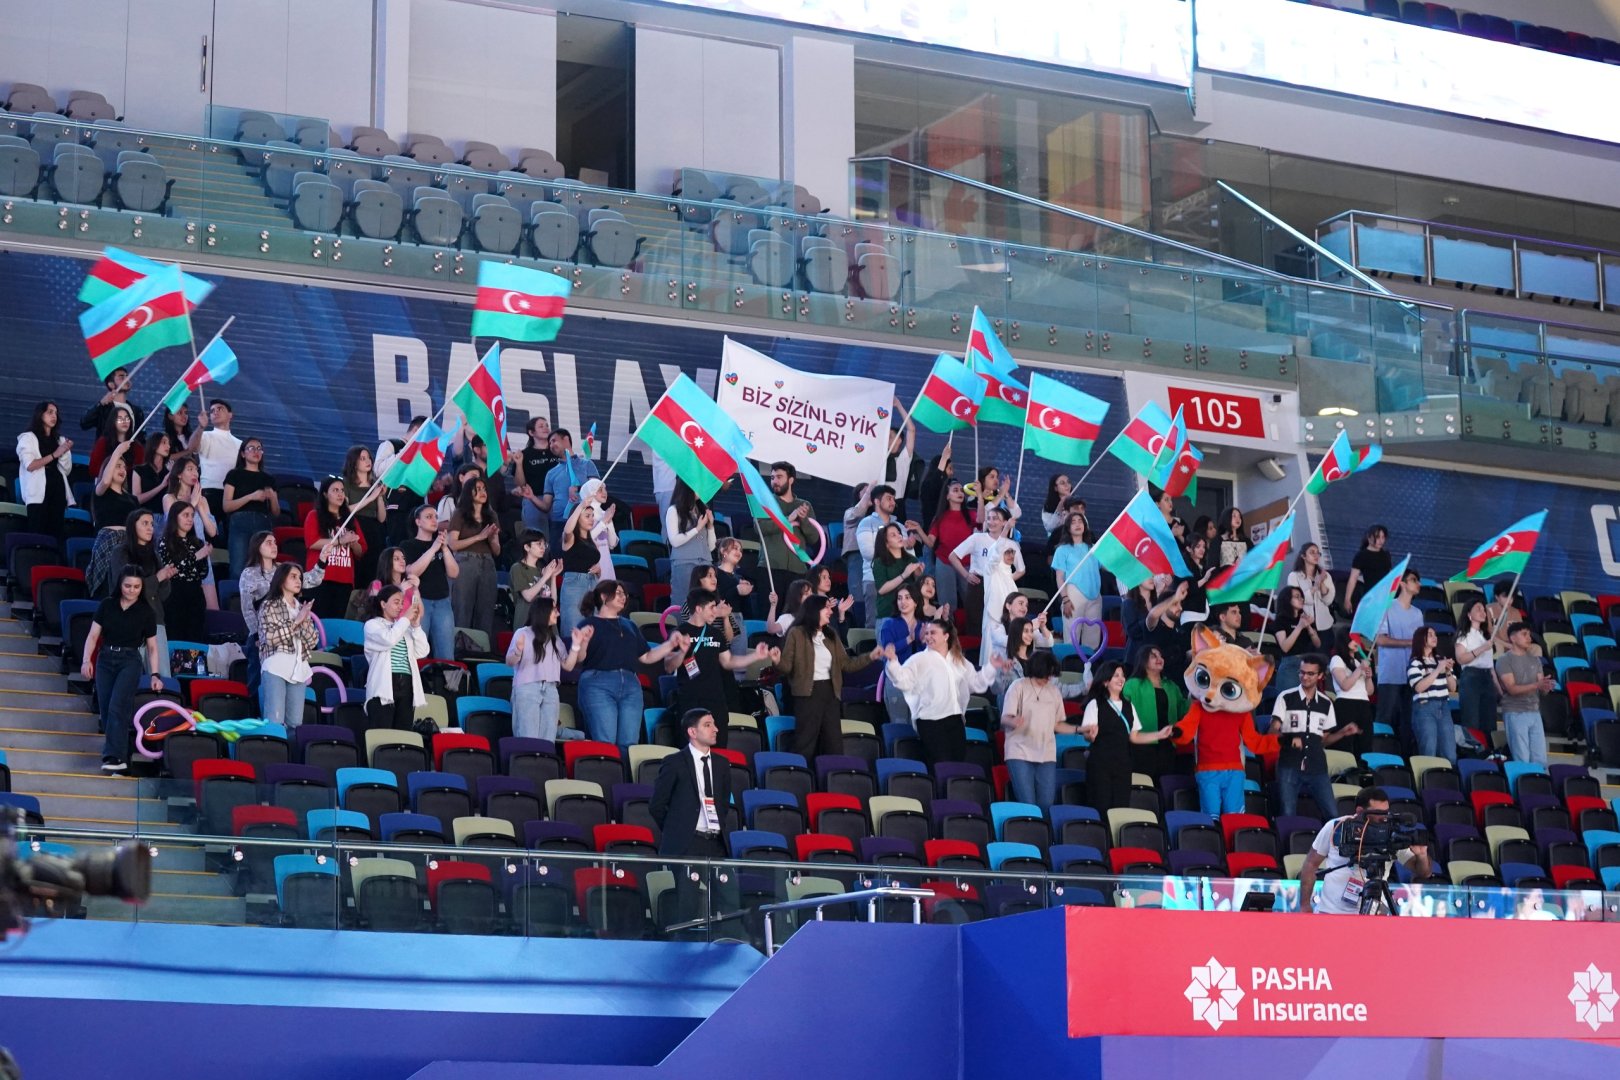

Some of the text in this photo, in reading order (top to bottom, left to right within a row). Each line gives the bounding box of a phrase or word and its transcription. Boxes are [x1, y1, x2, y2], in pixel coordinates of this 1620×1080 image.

[742, 386, 878, 438] BİZ SİZİNLƏYİK
[1190, 396, 1242, 429] 105
[773, 417, 845, 449] QIZLAR!
[1251, 966, 1333, 991] PASHA
[1253, 998, 1368, 1022] Insurance
